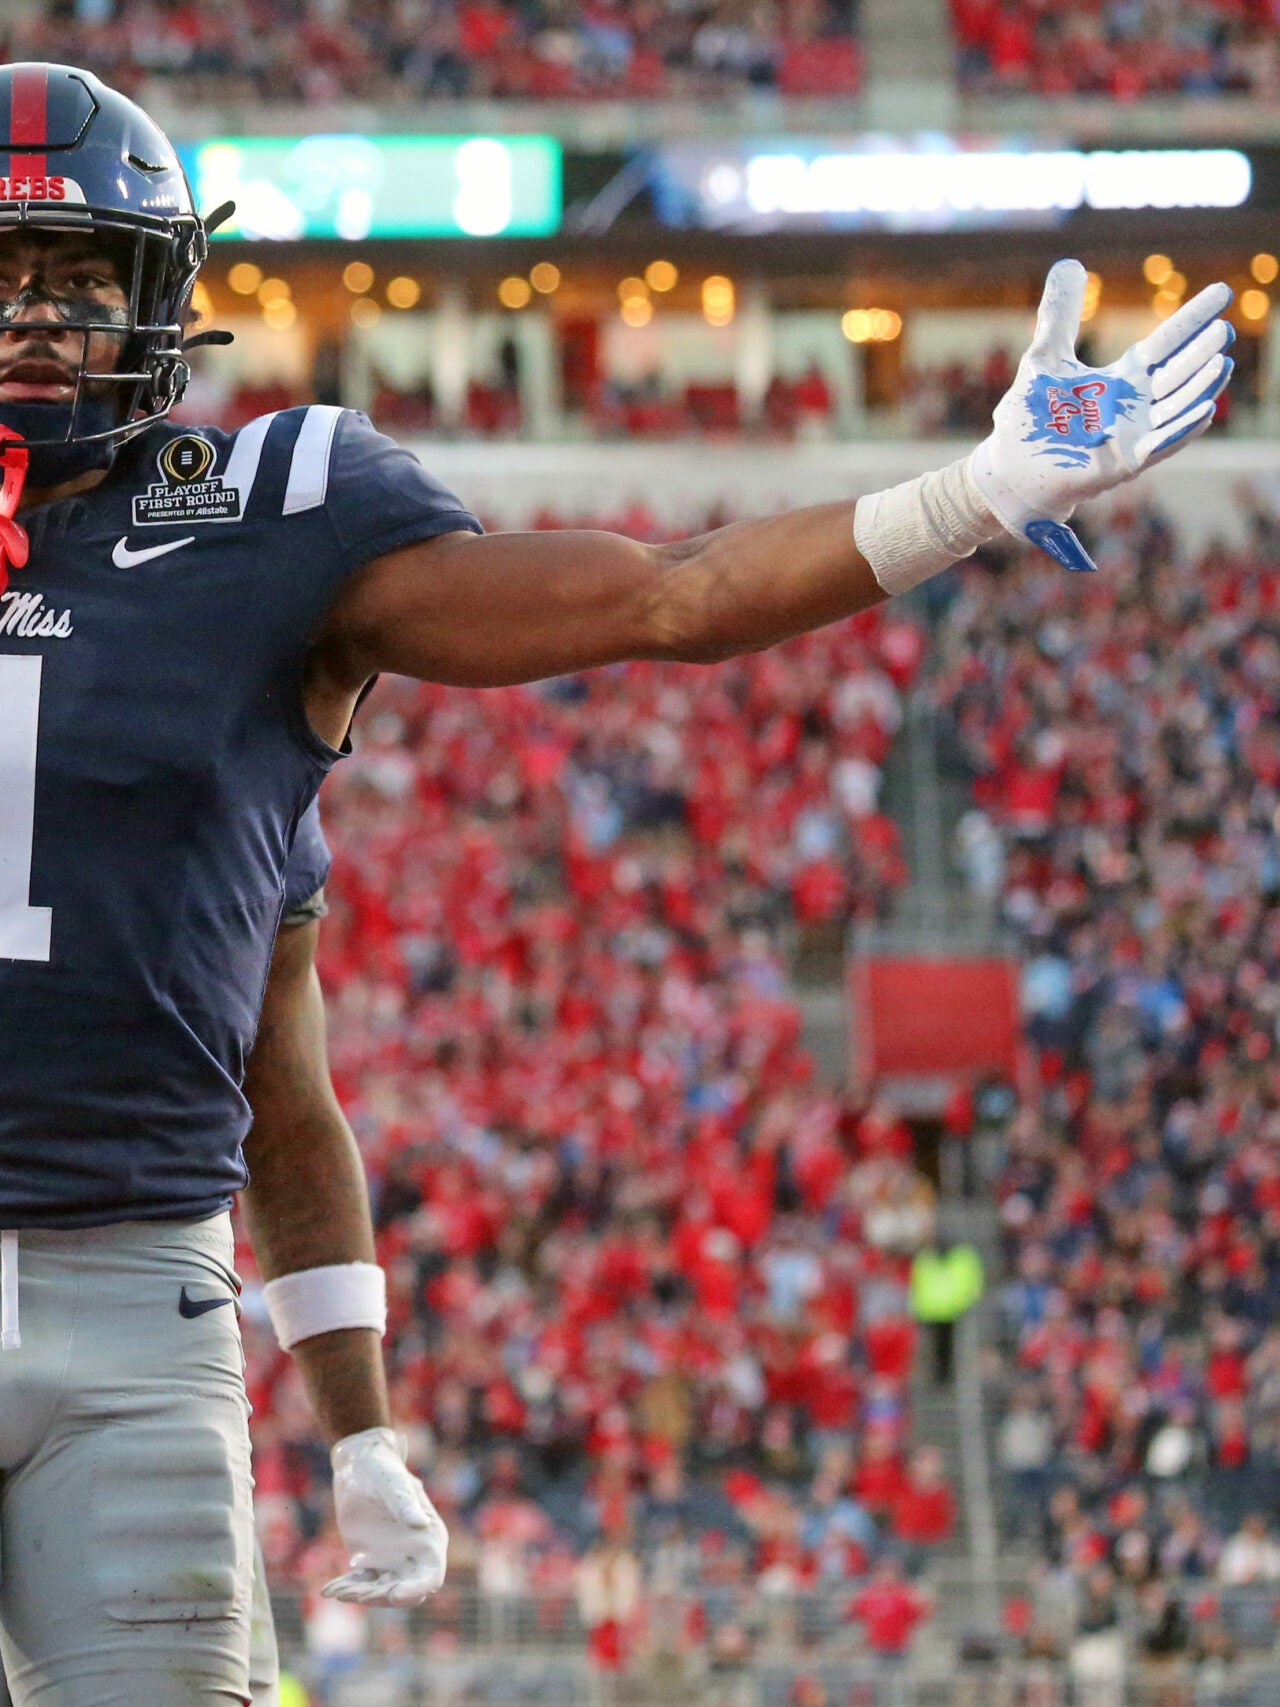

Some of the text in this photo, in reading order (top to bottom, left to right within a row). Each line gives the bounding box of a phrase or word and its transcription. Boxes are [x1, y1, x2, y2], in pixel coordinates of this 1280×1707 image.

[1072, 381, 1107, 434] Come
[1045, 400, 1082, 435] Sip
[154, 481, 219, 498] PLAYOFF
[138, 491, 236, 510] FIRST ROUND
[148, 509, 185, 518] PRESENTED
[195, 505, 228, 516] Allstate
